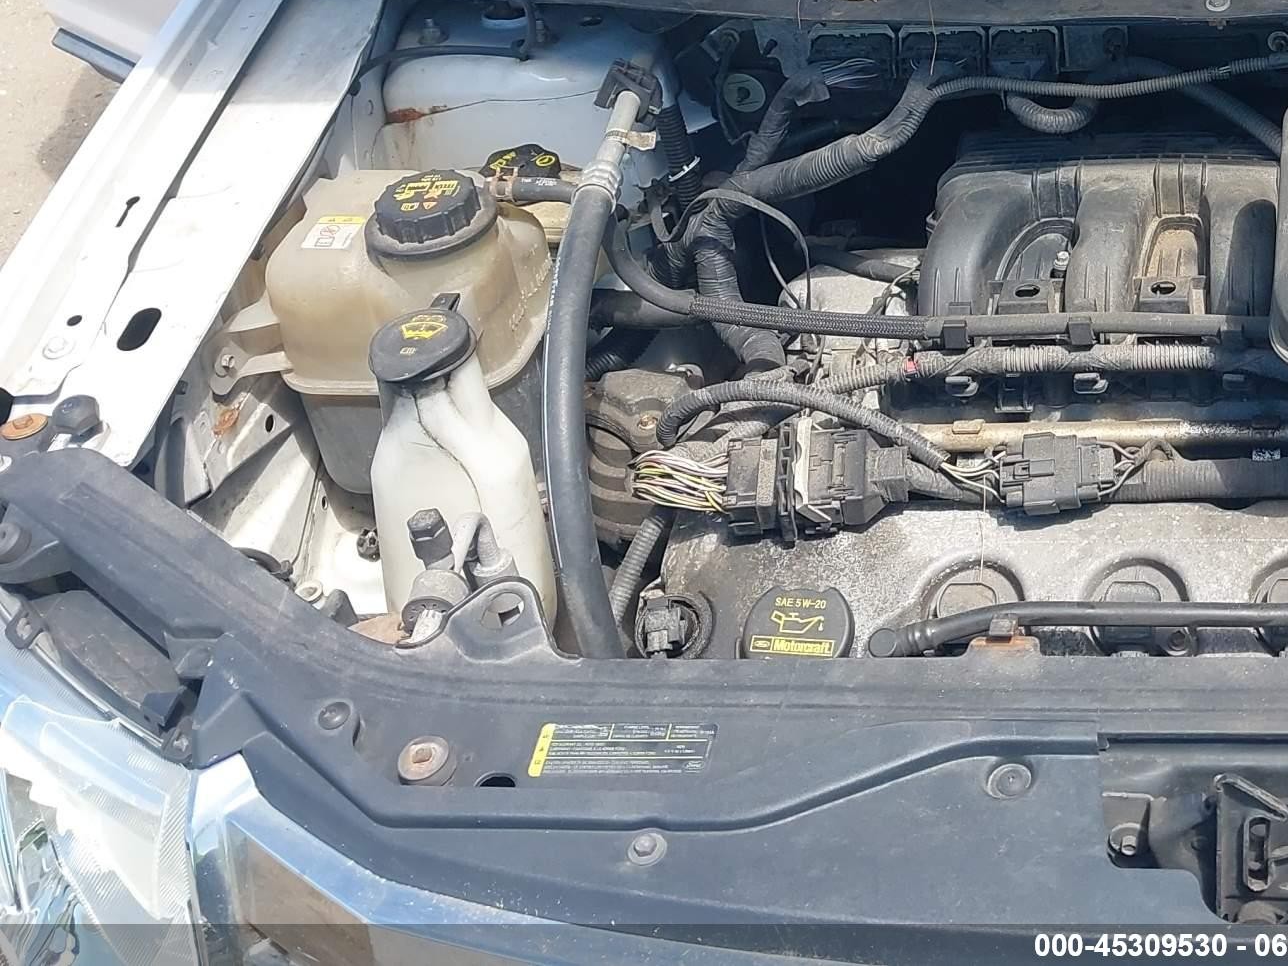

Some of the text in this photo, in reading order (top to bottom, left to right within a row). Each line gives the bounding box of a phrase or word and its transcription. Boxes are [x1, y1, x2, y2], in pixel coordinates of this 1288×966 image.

[775, 597, 827, 609] SAE 5W-20
[773, 639, 830, 654] Motorcraft
